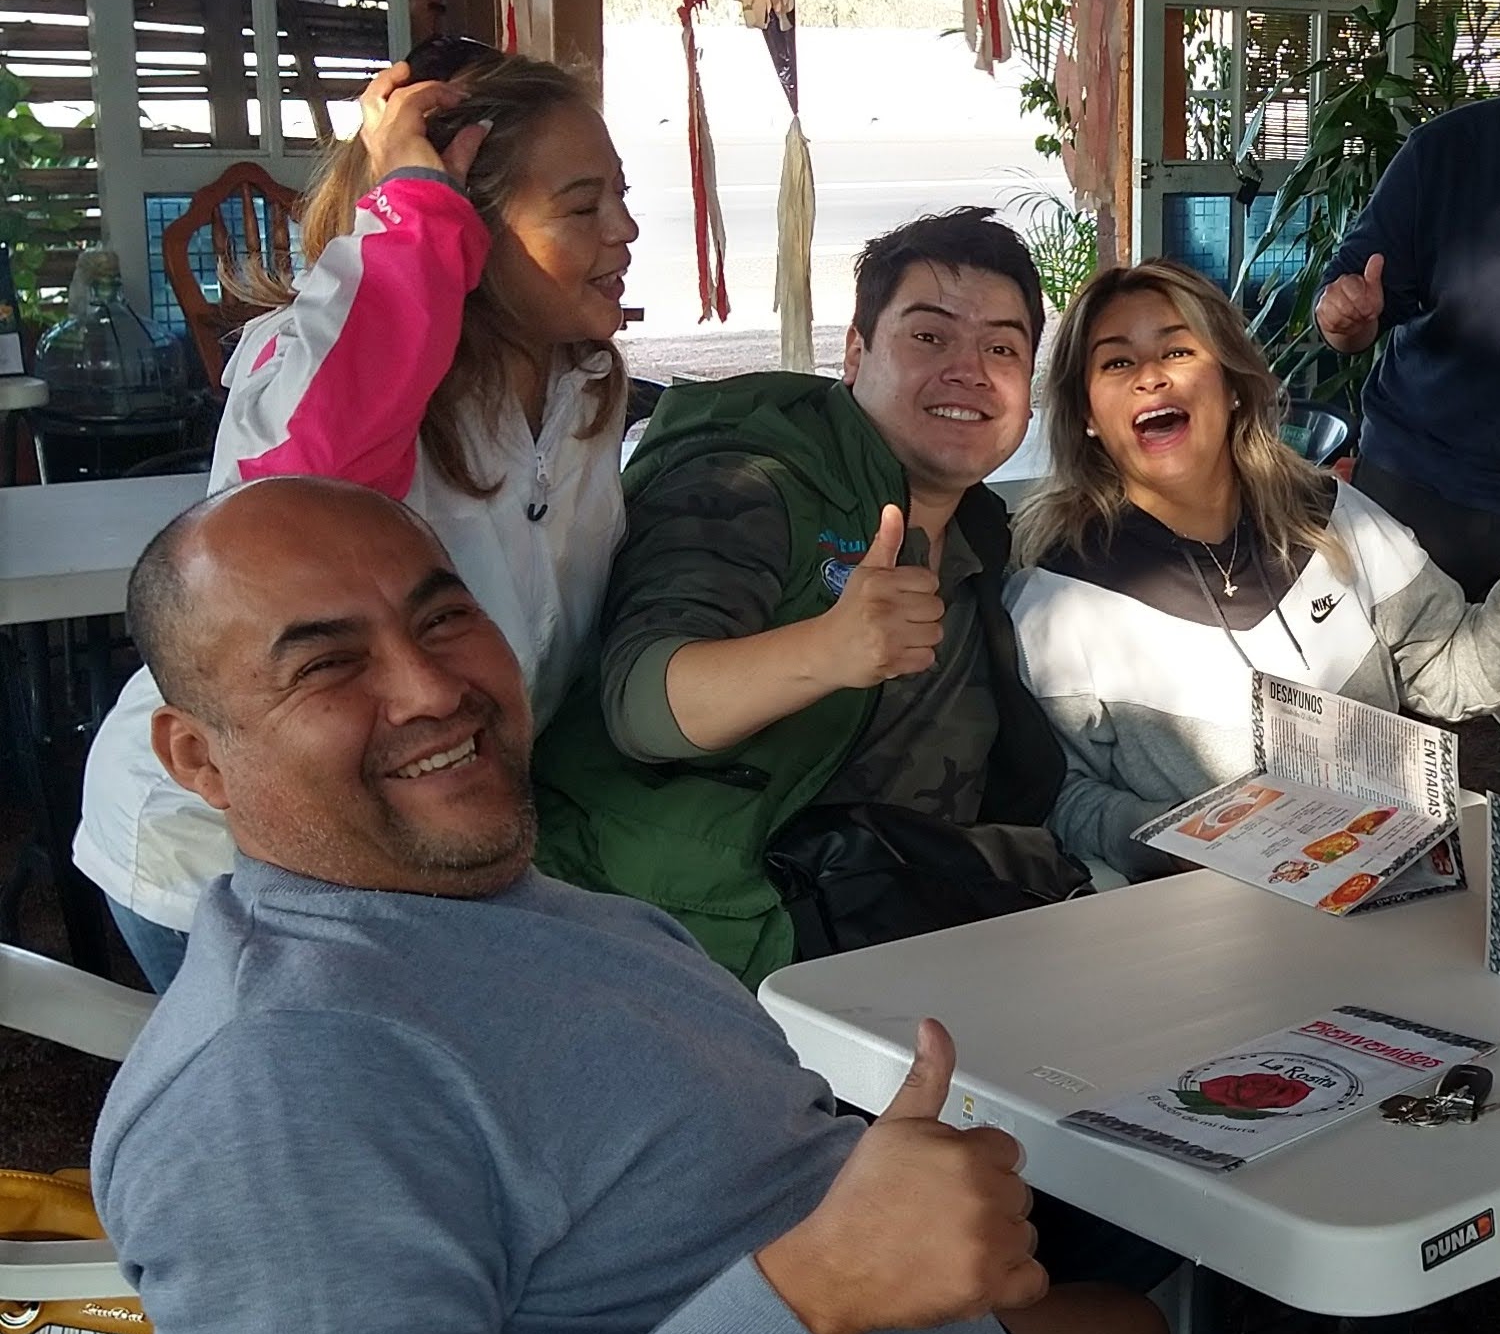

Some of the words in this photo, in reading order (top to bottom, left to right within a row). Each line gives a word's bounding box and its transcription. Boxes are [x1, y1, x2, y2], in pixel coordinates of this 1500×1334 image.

[1311, 593, 1333, 614] NIKE
[1270, 681, 1323, 715] DESAYUNOS
[1424, 738, 1442, 818] ENTRADAS
[1298, 1020, 1444, 1068] Bienvenidos
[1258, 1058, 1284, 1071] La
[1284, 1065, 1337, 1088] Rosita
[1199, 1120, 1218, 1128] mi
[1425, 1223, 1479, 1265] DUNA
